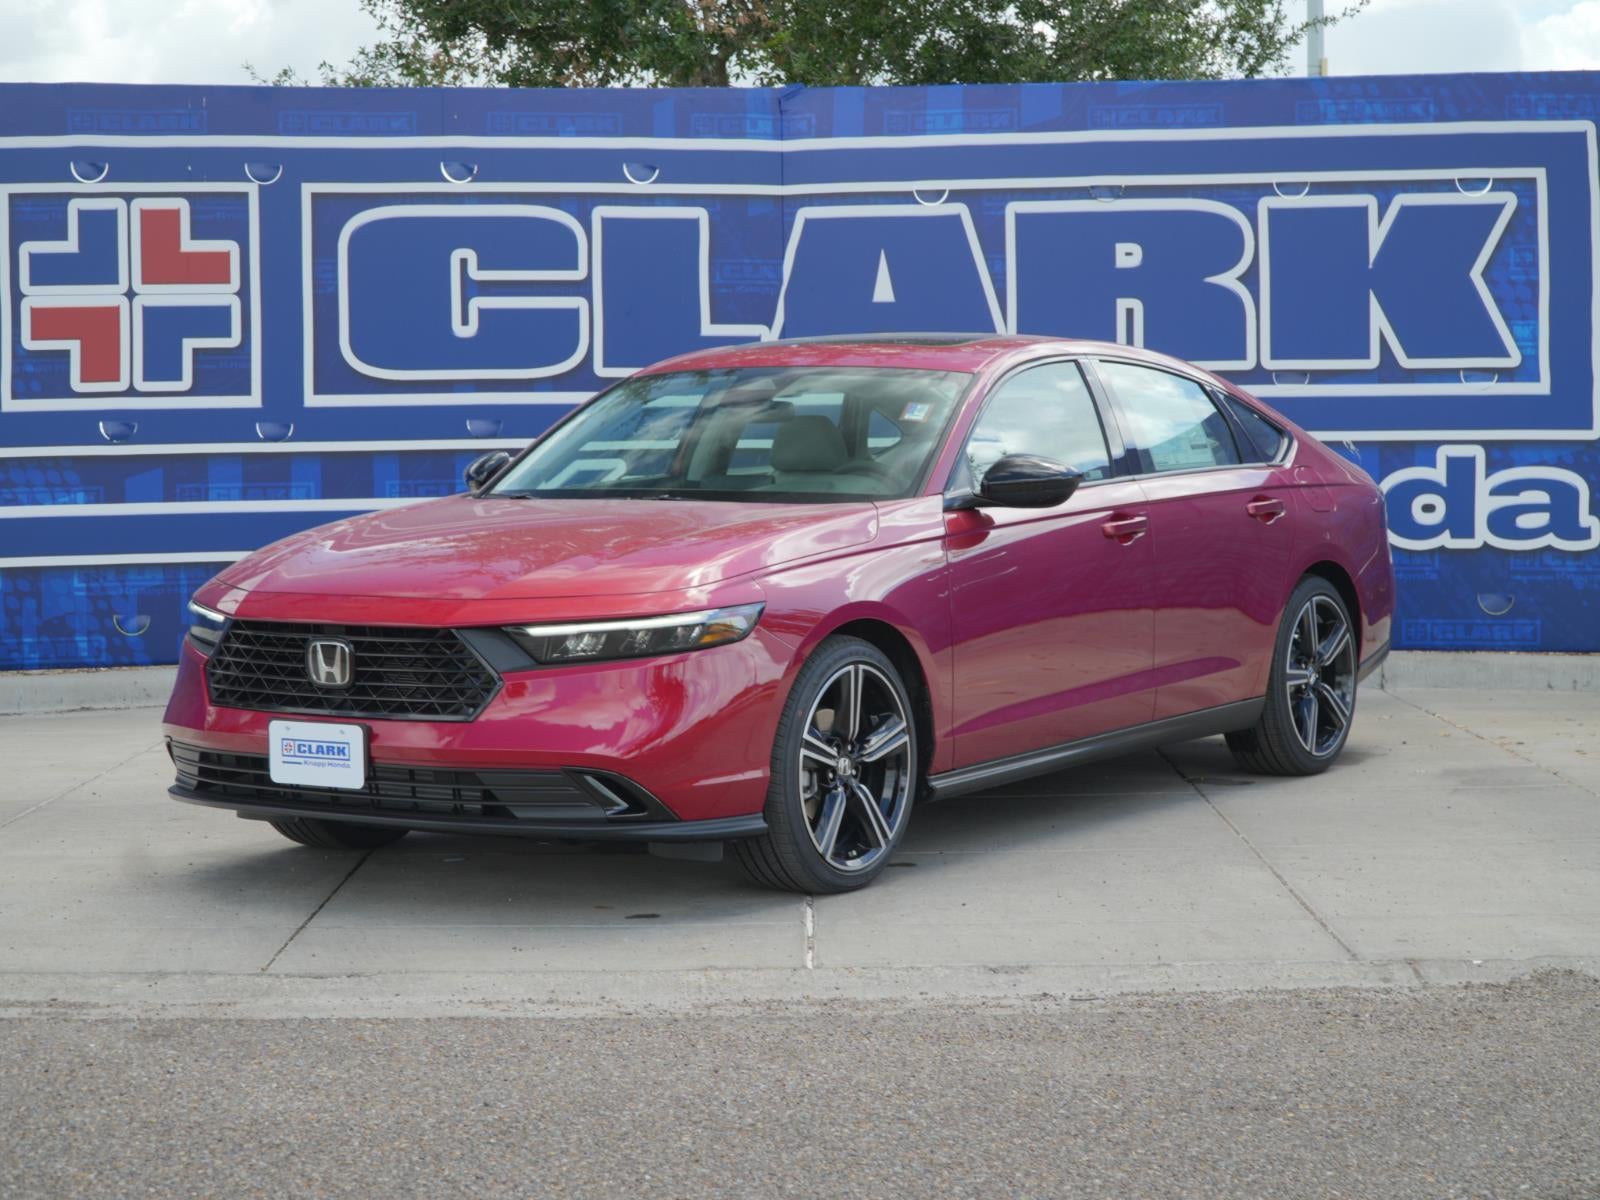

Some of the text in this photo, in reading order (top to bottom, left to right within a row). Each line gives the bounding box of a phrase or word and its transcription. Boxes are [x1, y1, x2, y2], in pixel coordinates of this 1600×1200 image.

[337, 191, 1522, 381] CLARK
[297, 743, 346, 757] CLARK
[303, 760, 351, 769] Knapp Honda
